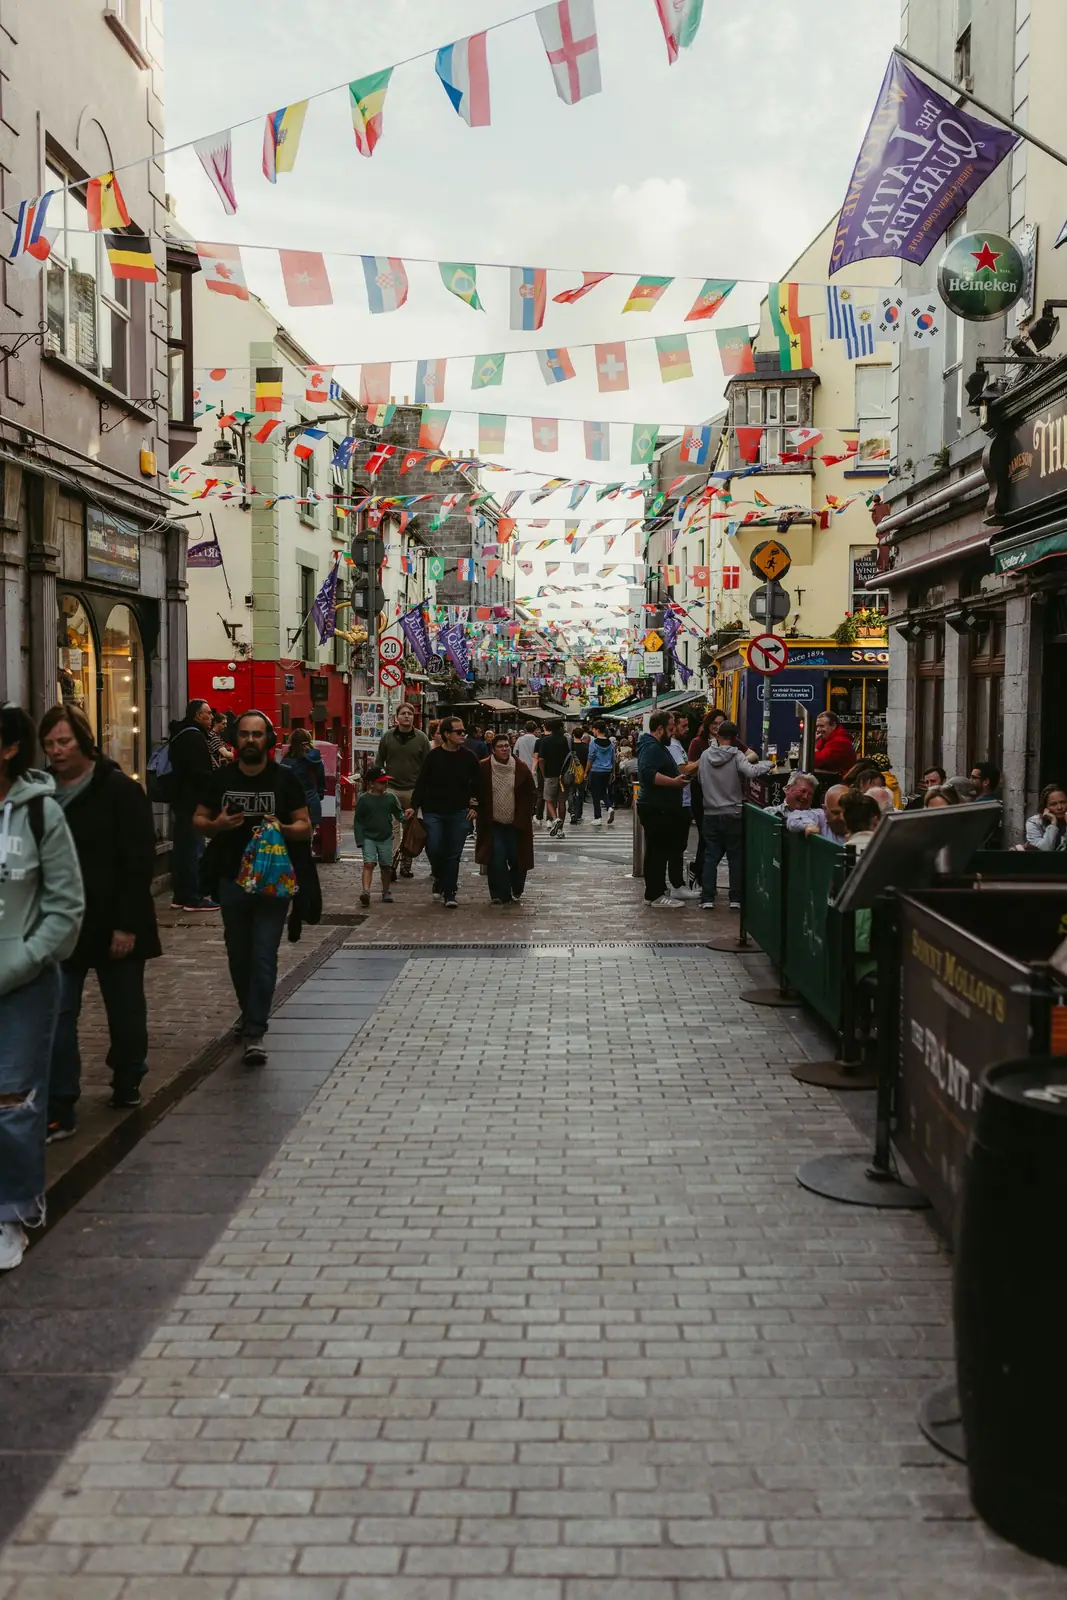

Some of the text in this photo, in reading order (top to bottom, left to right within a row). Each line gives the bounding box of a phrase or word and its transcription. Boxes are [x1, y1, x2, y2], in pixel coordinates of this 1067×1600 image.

[948, 278, 1017, 293] Heineken
[384, 642, 397, 654] 20
[807, 650, 825, 659] 1894
